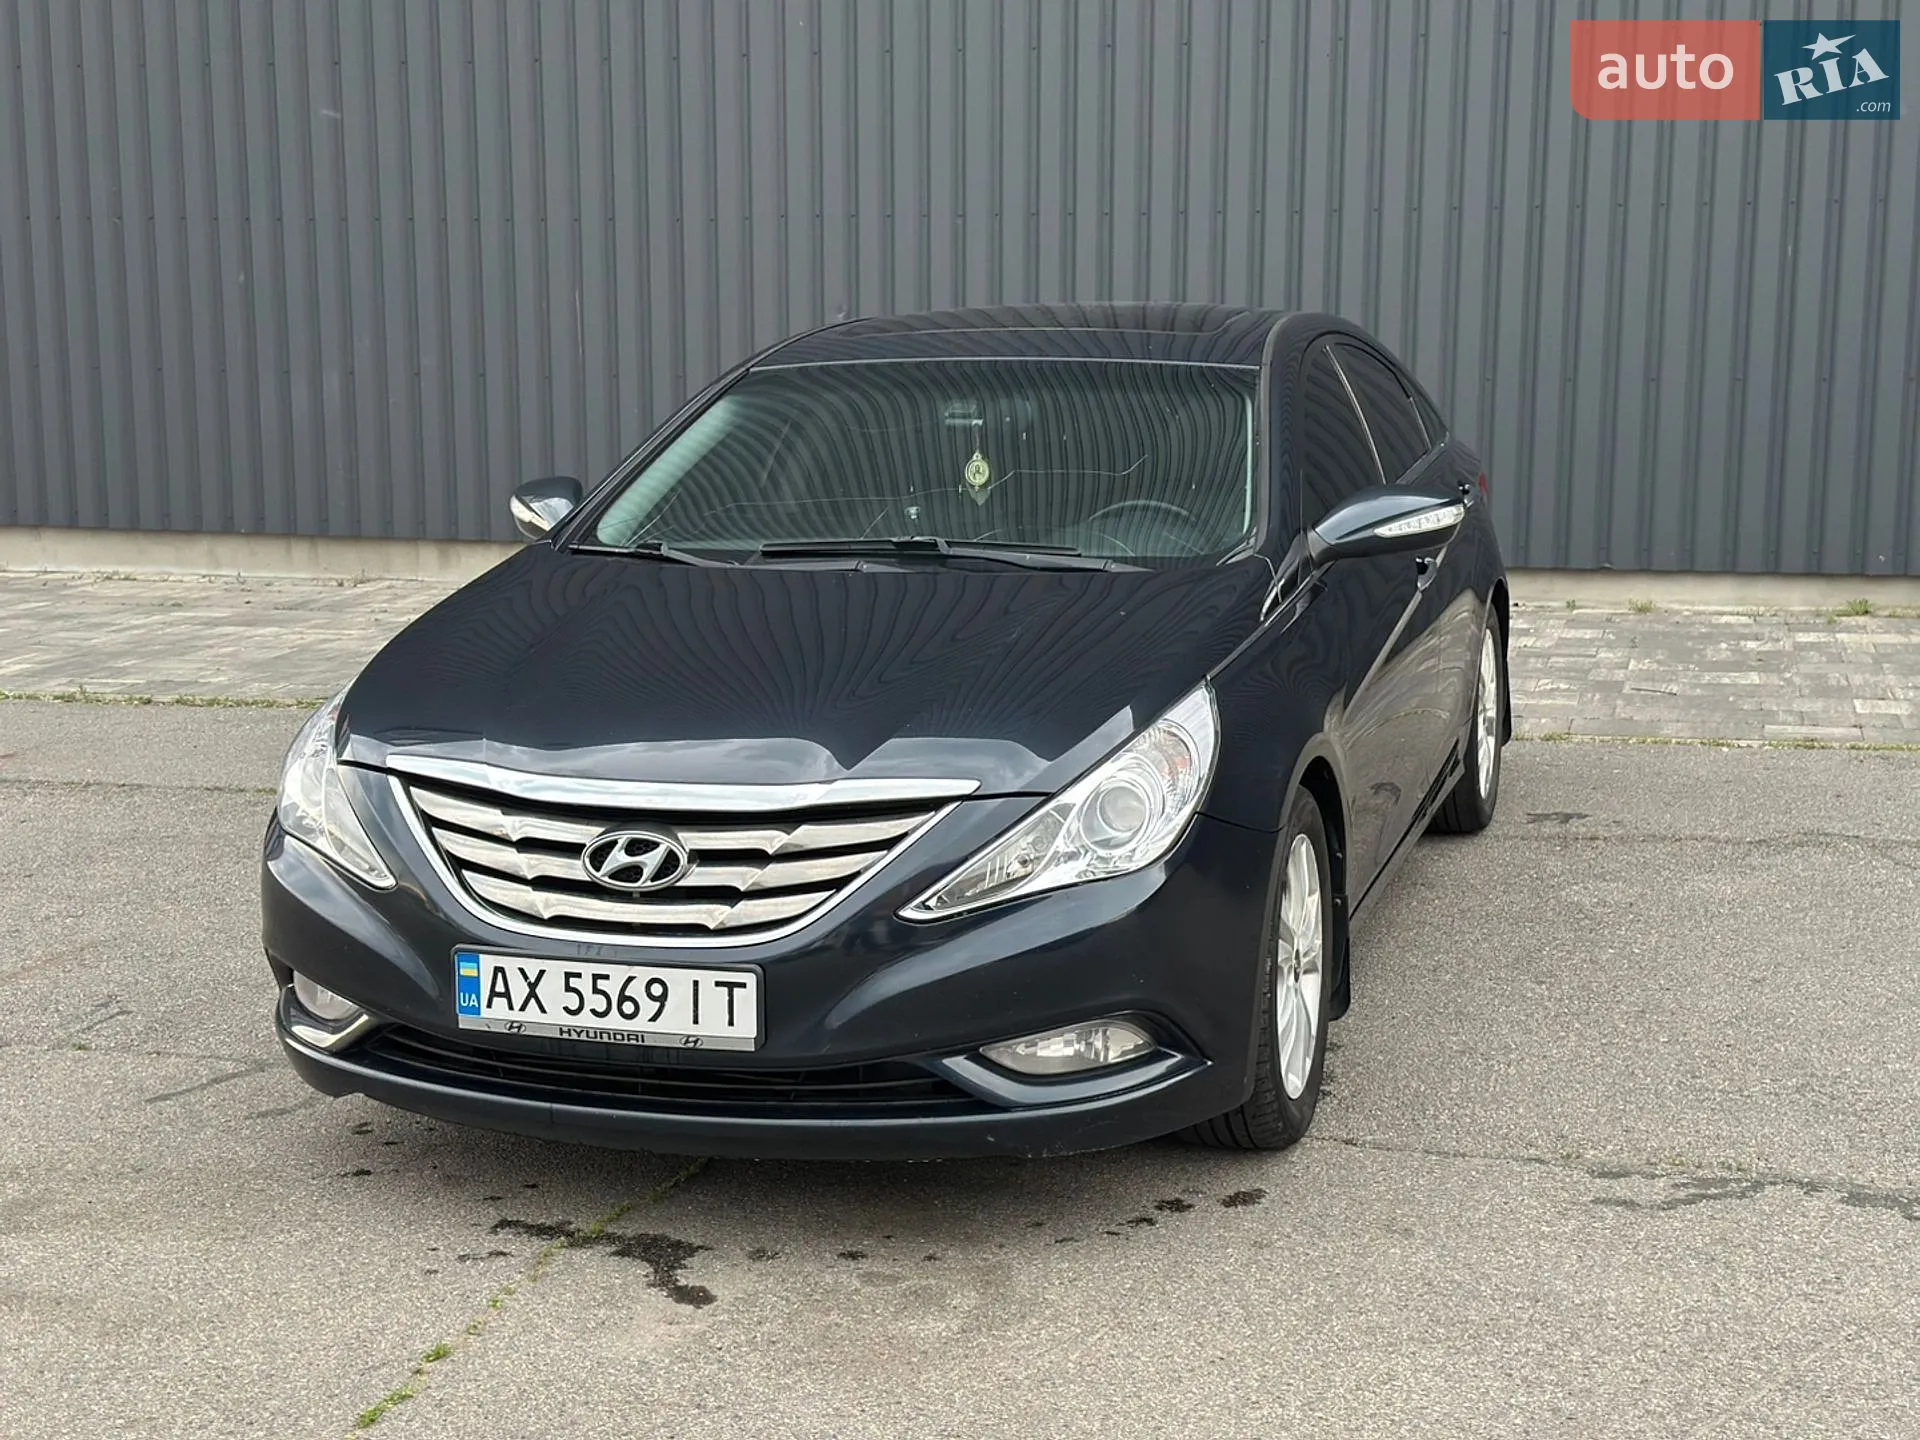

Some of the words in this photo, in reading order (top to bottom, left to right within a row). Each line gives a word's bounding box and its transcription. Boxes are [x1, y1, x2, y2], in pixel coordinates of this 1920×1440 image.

[459, 992, 479, 1007] UA
[485, 965, 548, 1014] AX
[562, 971, 669, 1022] 5569
[692, 979, 747, 1027] IT
[559, 1027, 645, 1043] HYUNDAI
